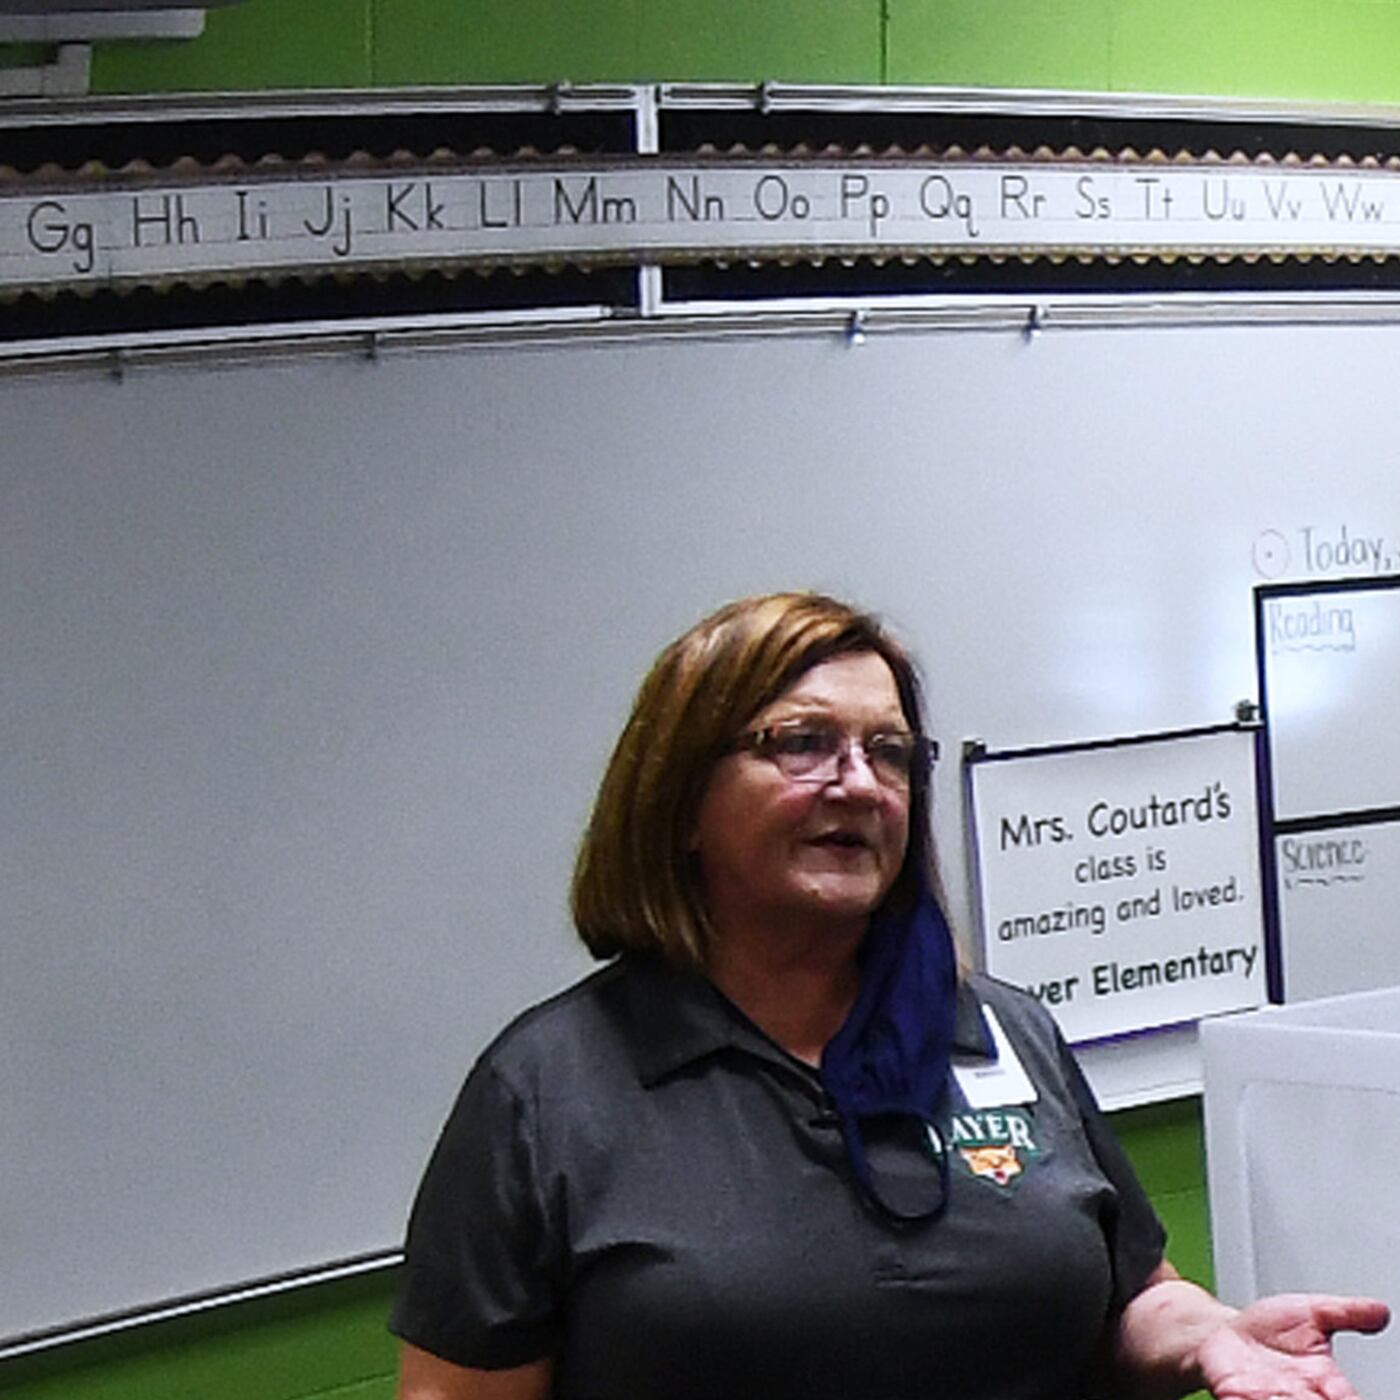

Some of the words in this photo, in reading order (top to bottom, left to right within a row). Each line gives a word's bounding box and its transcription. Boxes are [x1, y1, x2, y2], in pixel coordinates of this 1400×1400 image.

[27, 200, 96, 272] Gg
[133, 194, 199, 248] Hh
[236, 190, 268, 241] Ii
[303, 185, 352, 256] Jj
[387, 181, 445, 232] Kk
[479, 179, 521, 228] Ll
[554, 176, 637, 225] Mm
[667, 175, 724, 222] Nn
[754, 174, 810, 220] Oo
[841, 174, 889, 237] Pp
[919, 174, 979, 238] Qq
[1001, 174, 1046, 218] Rr
[1075, 175, 1111, 220] Ss
[1134, 177, 1174, 219] Tt
[1203, 178, 1245, 220] Uu
[1263, 180, 1302, 221] Vv
[1320, 183, 1385, 223] Ww
[1300, 524, 1391, 573] Today,
[1000, 814, 1074, 851] Mrs.
[1088, 781, 1231, 837] Coutard's
[1074, 852, 1137, 883] class
[1148, 847, 1167, 872] is
[998, 901, 1106, 941] amazing
[1116, 889, 1161, 922] and
[1172, 876, 1245, 914] loved.
[1092, 945, 1257, 997] Elementary
